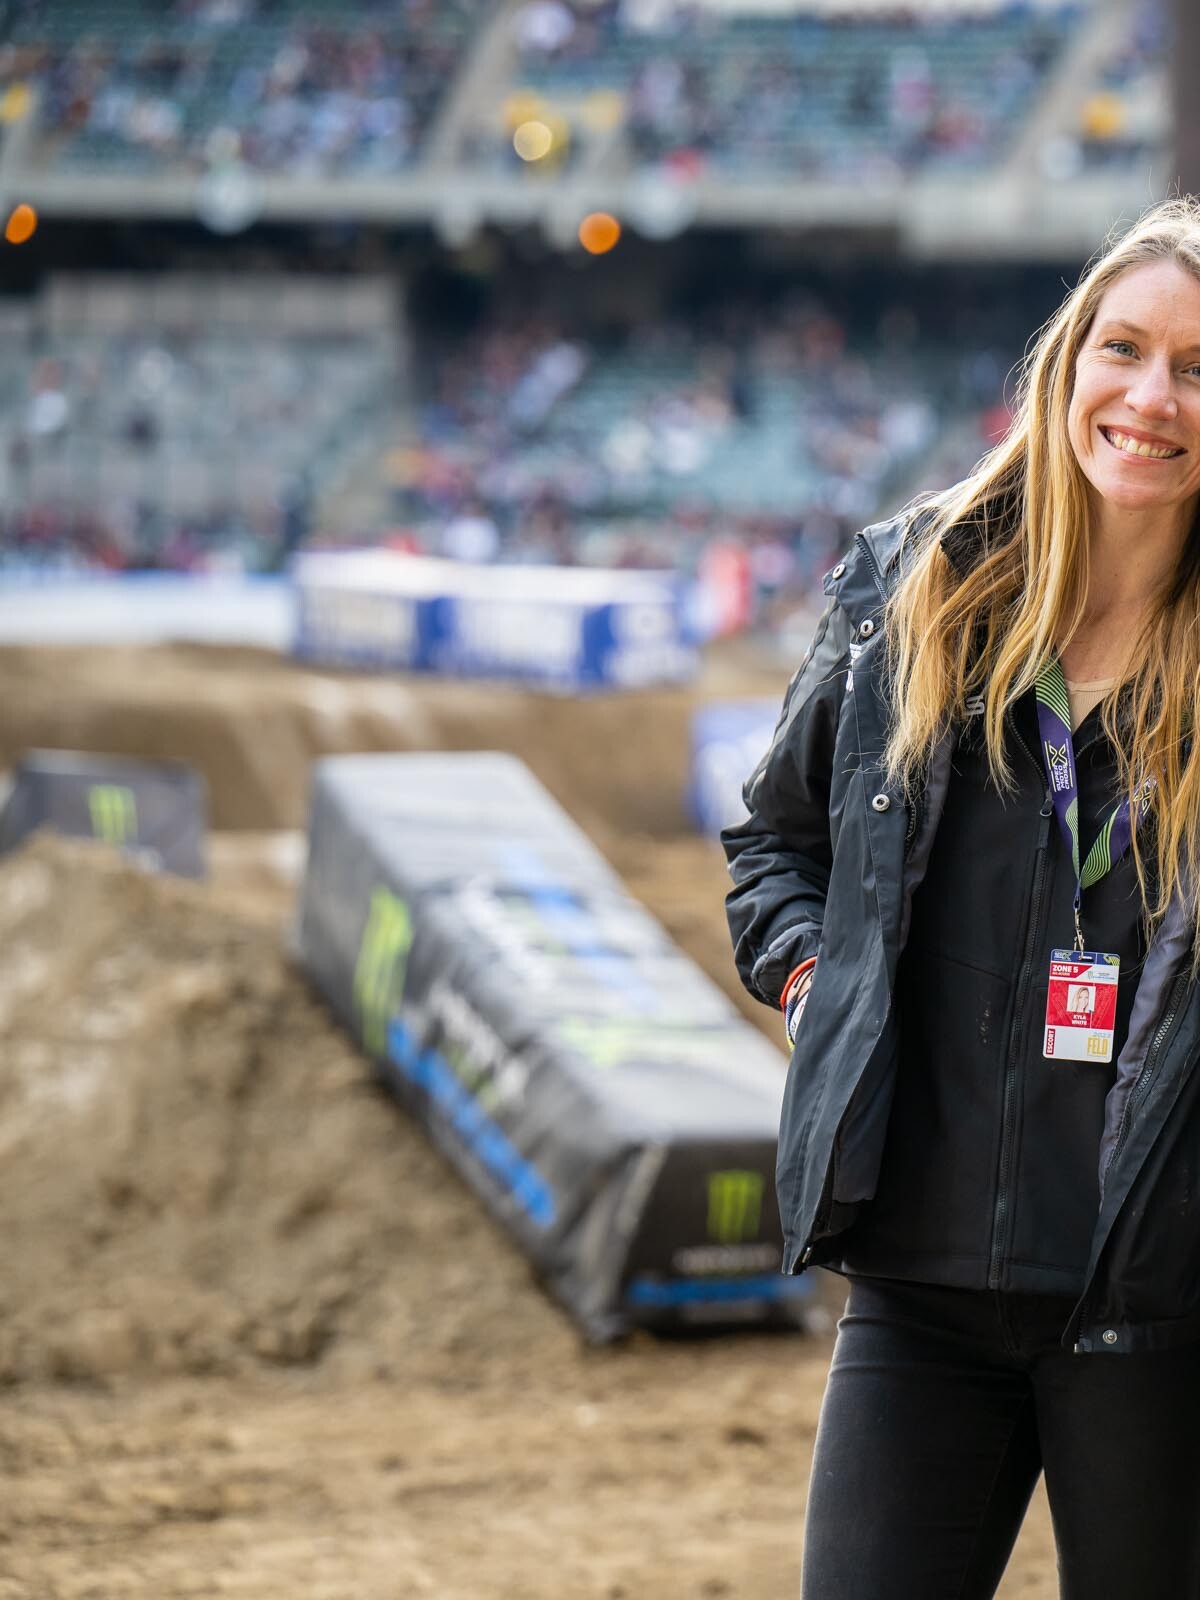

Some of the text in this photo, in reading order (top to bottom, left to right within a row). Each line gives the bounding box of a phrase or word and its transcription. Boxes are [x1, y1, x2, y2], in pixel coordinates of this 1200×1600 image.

[1054, 765, 1062, 791] SUPER
[1052, 964, 1072, 973] ZONE
[1047, 1030, 1055, 1054] ESCORT
